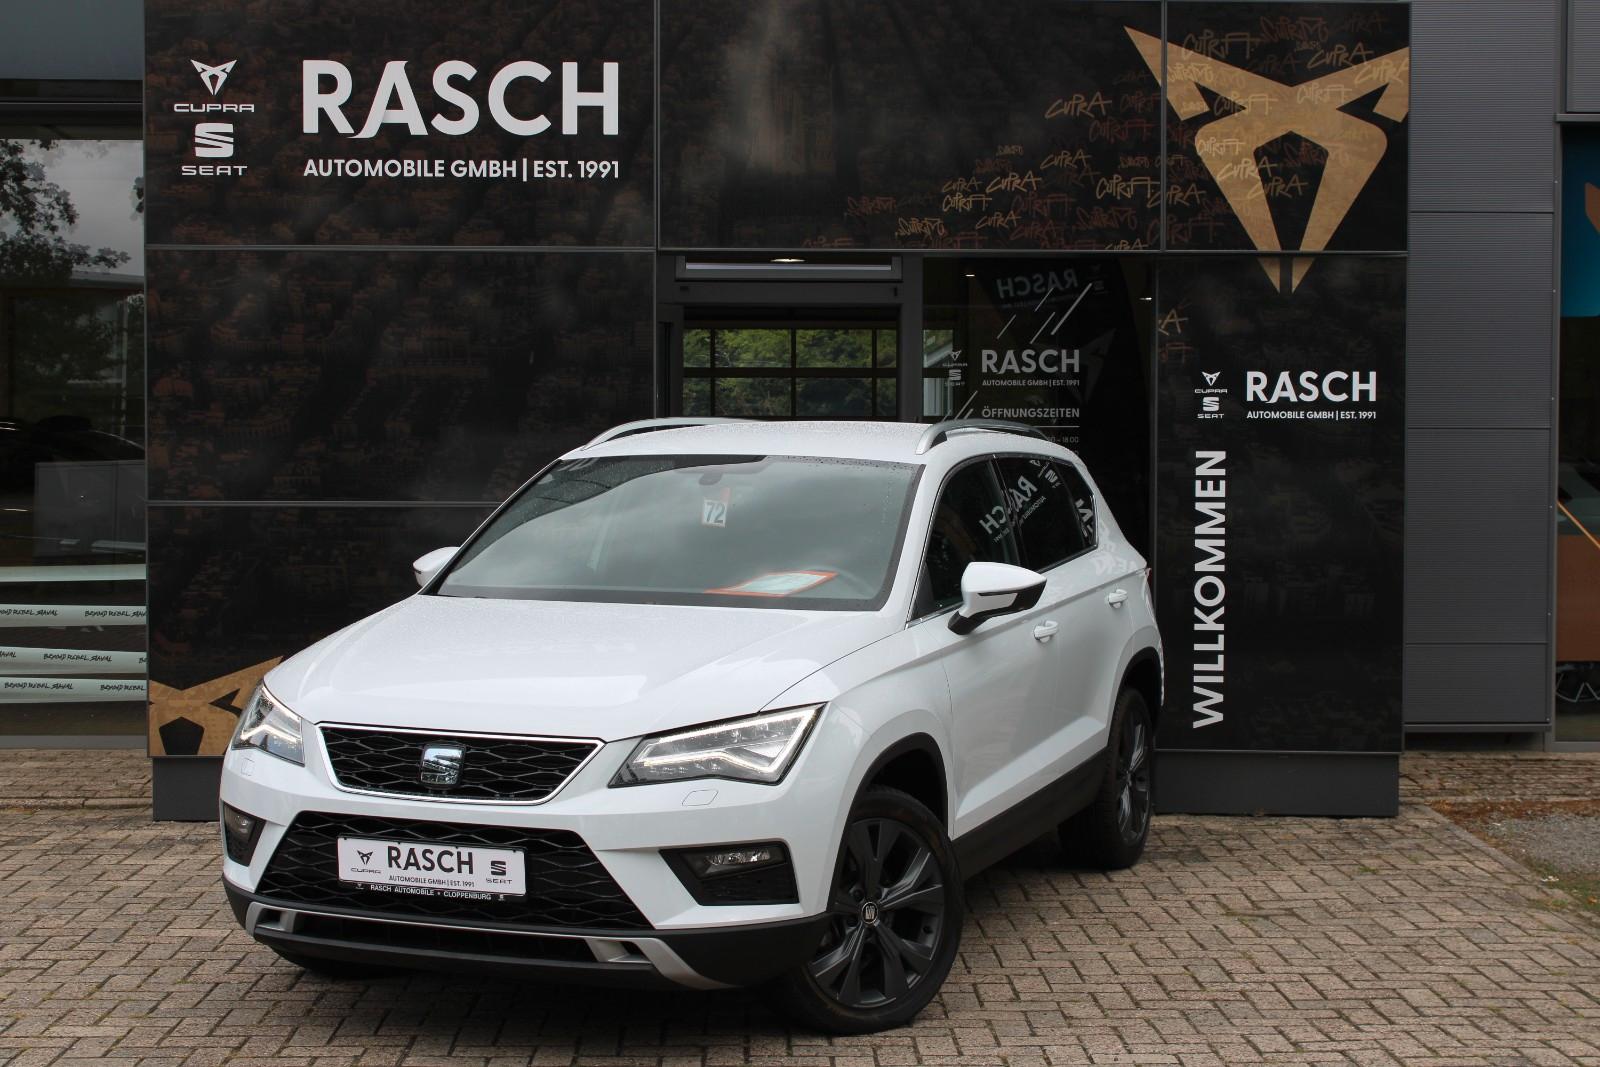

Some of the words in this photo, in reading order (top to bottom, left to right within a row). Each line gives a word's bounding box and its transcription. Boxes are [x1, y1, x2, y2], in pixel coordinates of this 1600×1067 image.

[1307, 42, 1375, 69] CUPRA
[173, 103, 255, 113] CUPRA
[302, 59, 619, 138] RASCH
[1045, 91, 1112, 119] CUPRA
[303, 159, 445, 178] AUTOMOBILE
[450, 160, 518, 178] GMBH
[533, 160, 572, 178] EST.
[577, 161, 619, 179] 1991
[1040, 149, 1091, 170] CUPRA
[1217, 156, 1277, 180] CUPRA
[181, 165, 248, 176] SEAT
[942, 177, 983, 193] CUPRA
[986, 170, 1042, 193] CUPRA
[1247, 174, 1308, 199] CUPRA
[975, 210, 1021, 230] CUPRA
[981, 349, 1080, 374] RASCH
[982, 379, 1026, 387] AUTOMOBILE
[1027, 379, 1048, 387] GMBH
[1053, 379, 1066, 387] EST.
[1067, 379, 1080, 387] 1991
[1246, 370, 1377, 404] RASCH
[981, 405, 1080, 418] ÖFFNUNGSZEITEN
[1246, 410, 1305, 420] AUTOMOBILE
[1307, 410, 1334, 420] GMBH
[1340, 410, 1357, 420] EST.
[1359, 410, 1377, 420] 1991
[706, 502, 726, 524] 72
[1192, 450, 1227, 729] WILLKOMMEN
[387, 845, 474, 875] RASCH
[388, 875, 427, 884] AUTOMOBILE
[485, 877, 513, 885] SEAT
[370, 884, 392, 892] RASCH
[394, 885, 435, 896] AUTOMOBILE
[443, 890, 492, 900] CLOPPENBURG
